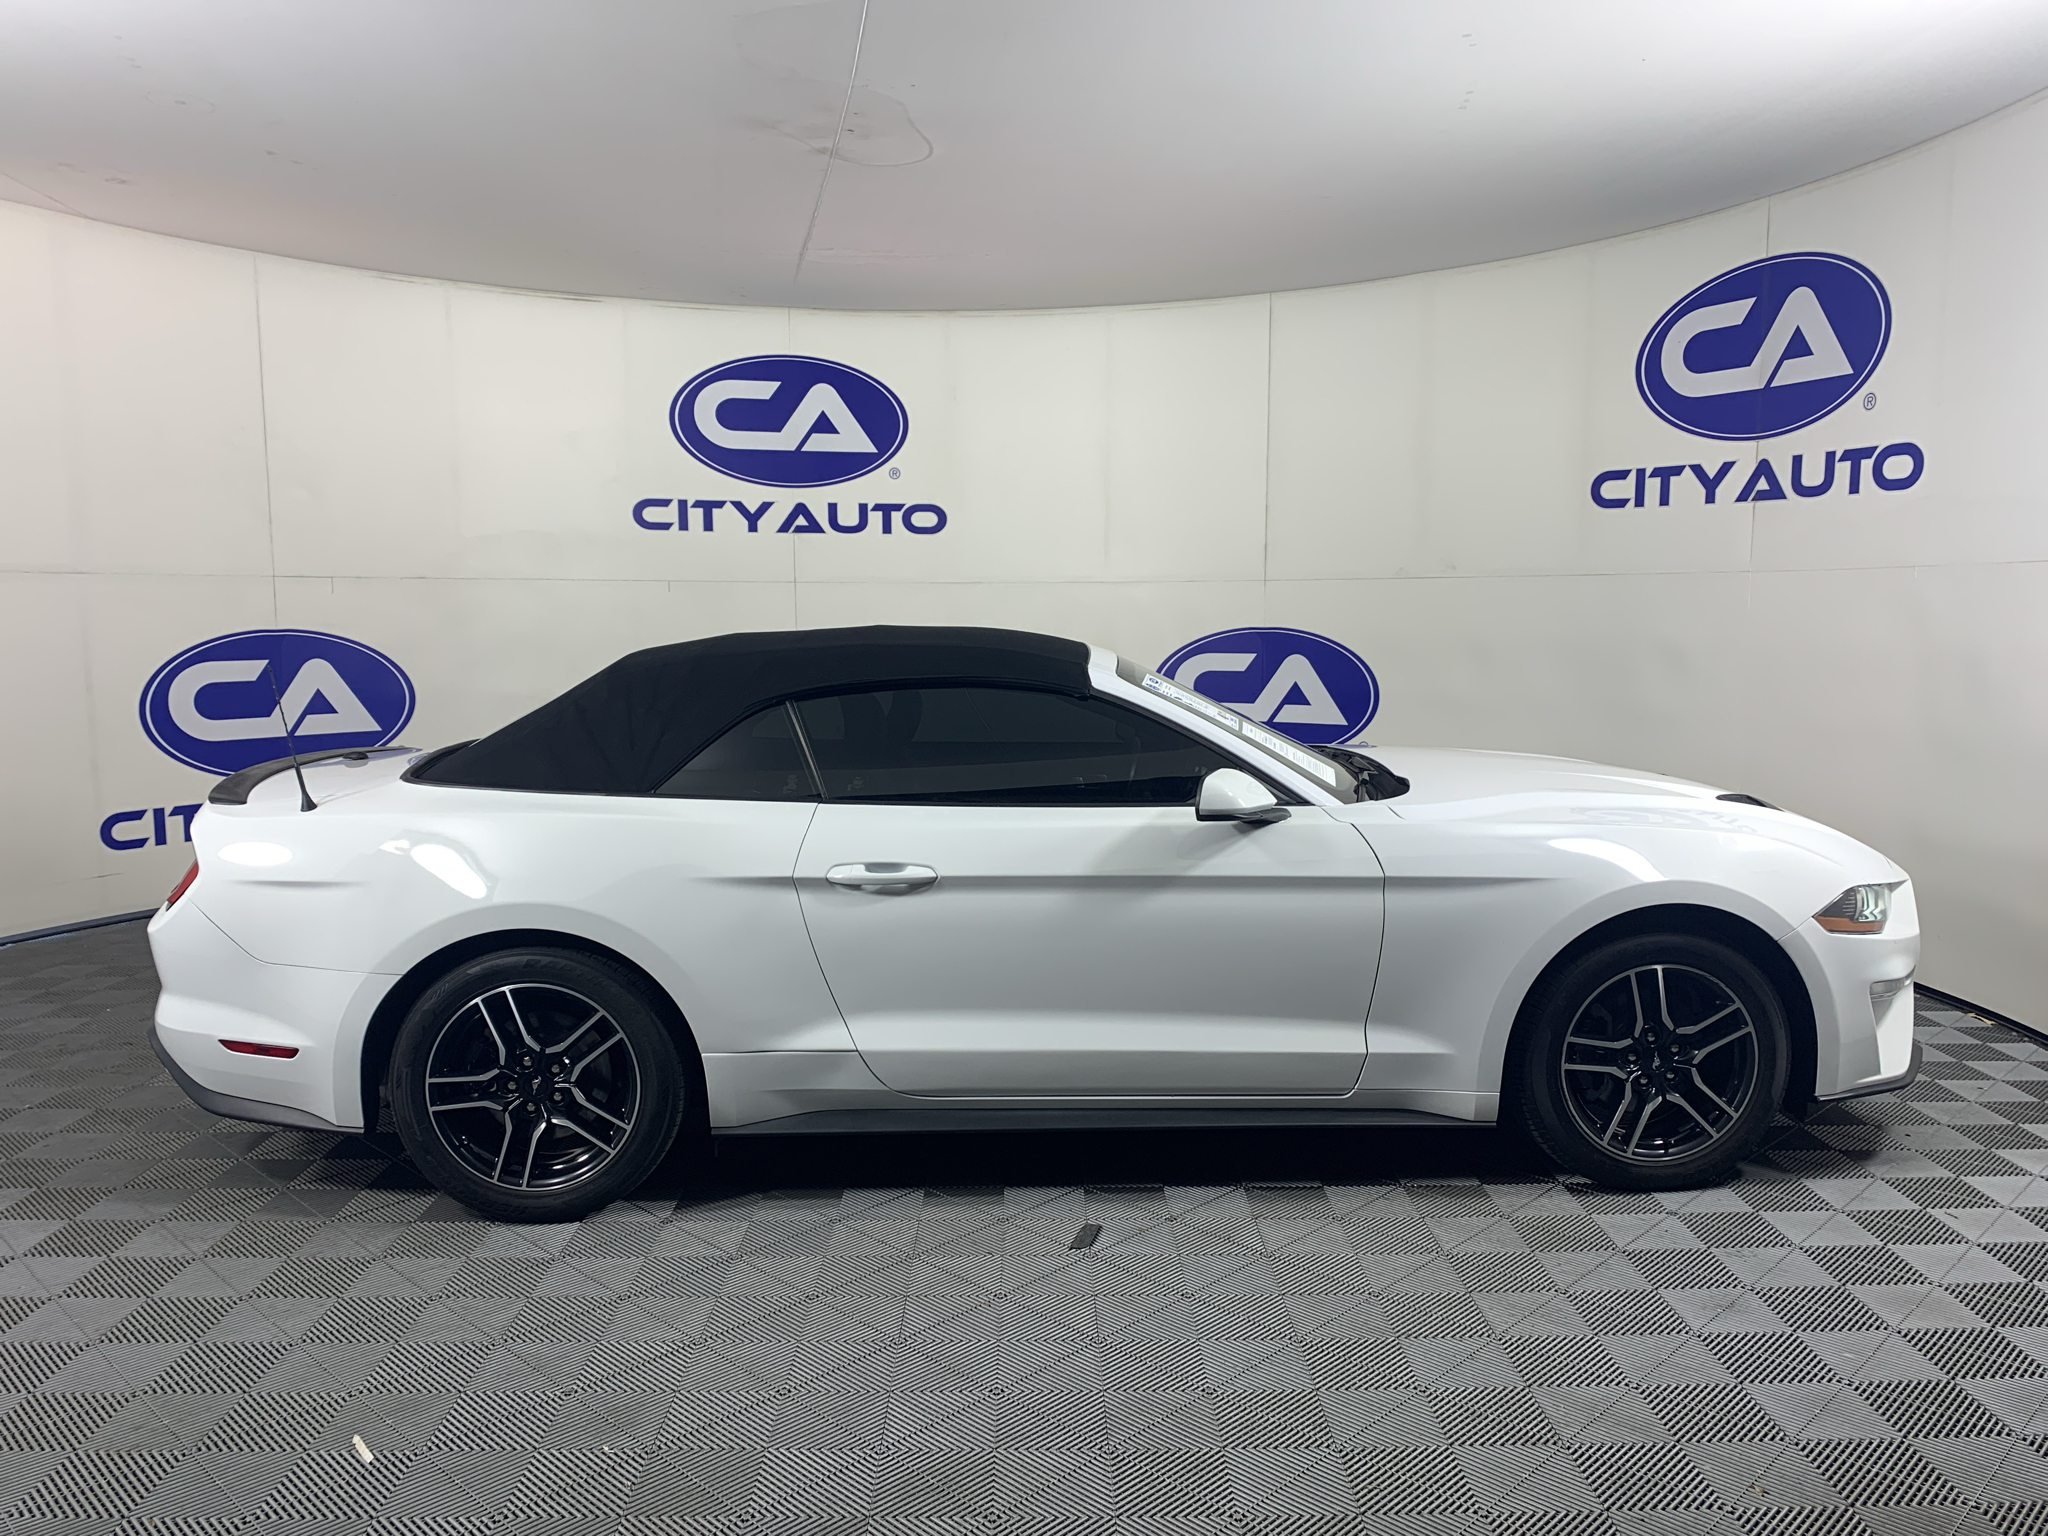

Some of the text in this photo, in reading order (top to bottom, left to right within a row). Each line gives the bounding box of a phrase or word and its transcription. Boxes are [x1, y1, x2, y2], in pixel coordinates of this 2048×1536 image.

[1661, 286, 1855, 398] CA
[694, 379, 879, 453] CA
[168, 658, 383, 742] CA
[1173, 652, 1349, 726] CA
